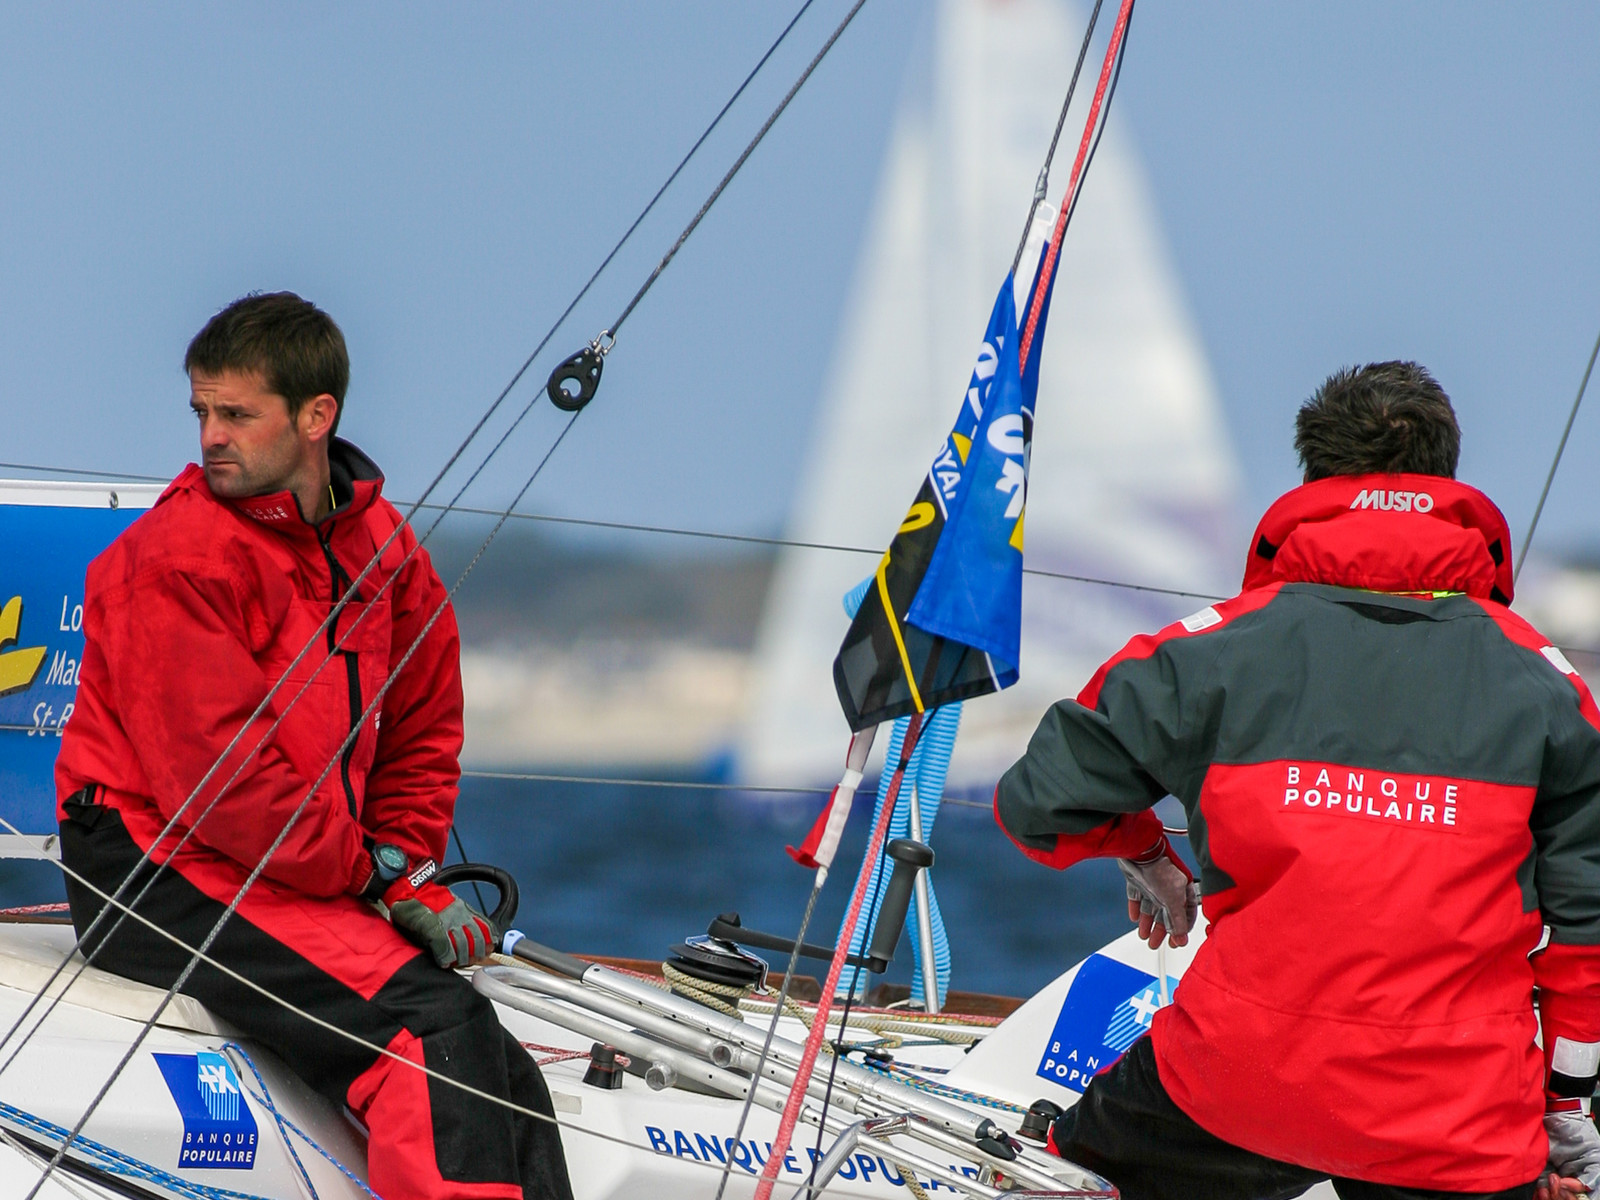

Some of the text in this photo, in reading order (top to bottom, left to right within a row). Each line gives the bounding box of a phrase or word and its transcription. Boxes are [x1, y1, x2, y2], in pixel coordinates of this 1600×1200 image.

[1350, 489, 1434, 514] MUSTO
[1287, 765, 1458, 804] BANQUE
[1284, 788, 1457, 826] POPULAIRE
[185, 1132, 255, 1146] BANQUE
[645, 1125, 802, 1175] BANQUE
[182, 1149, 253, 1163] POPULAIRE
